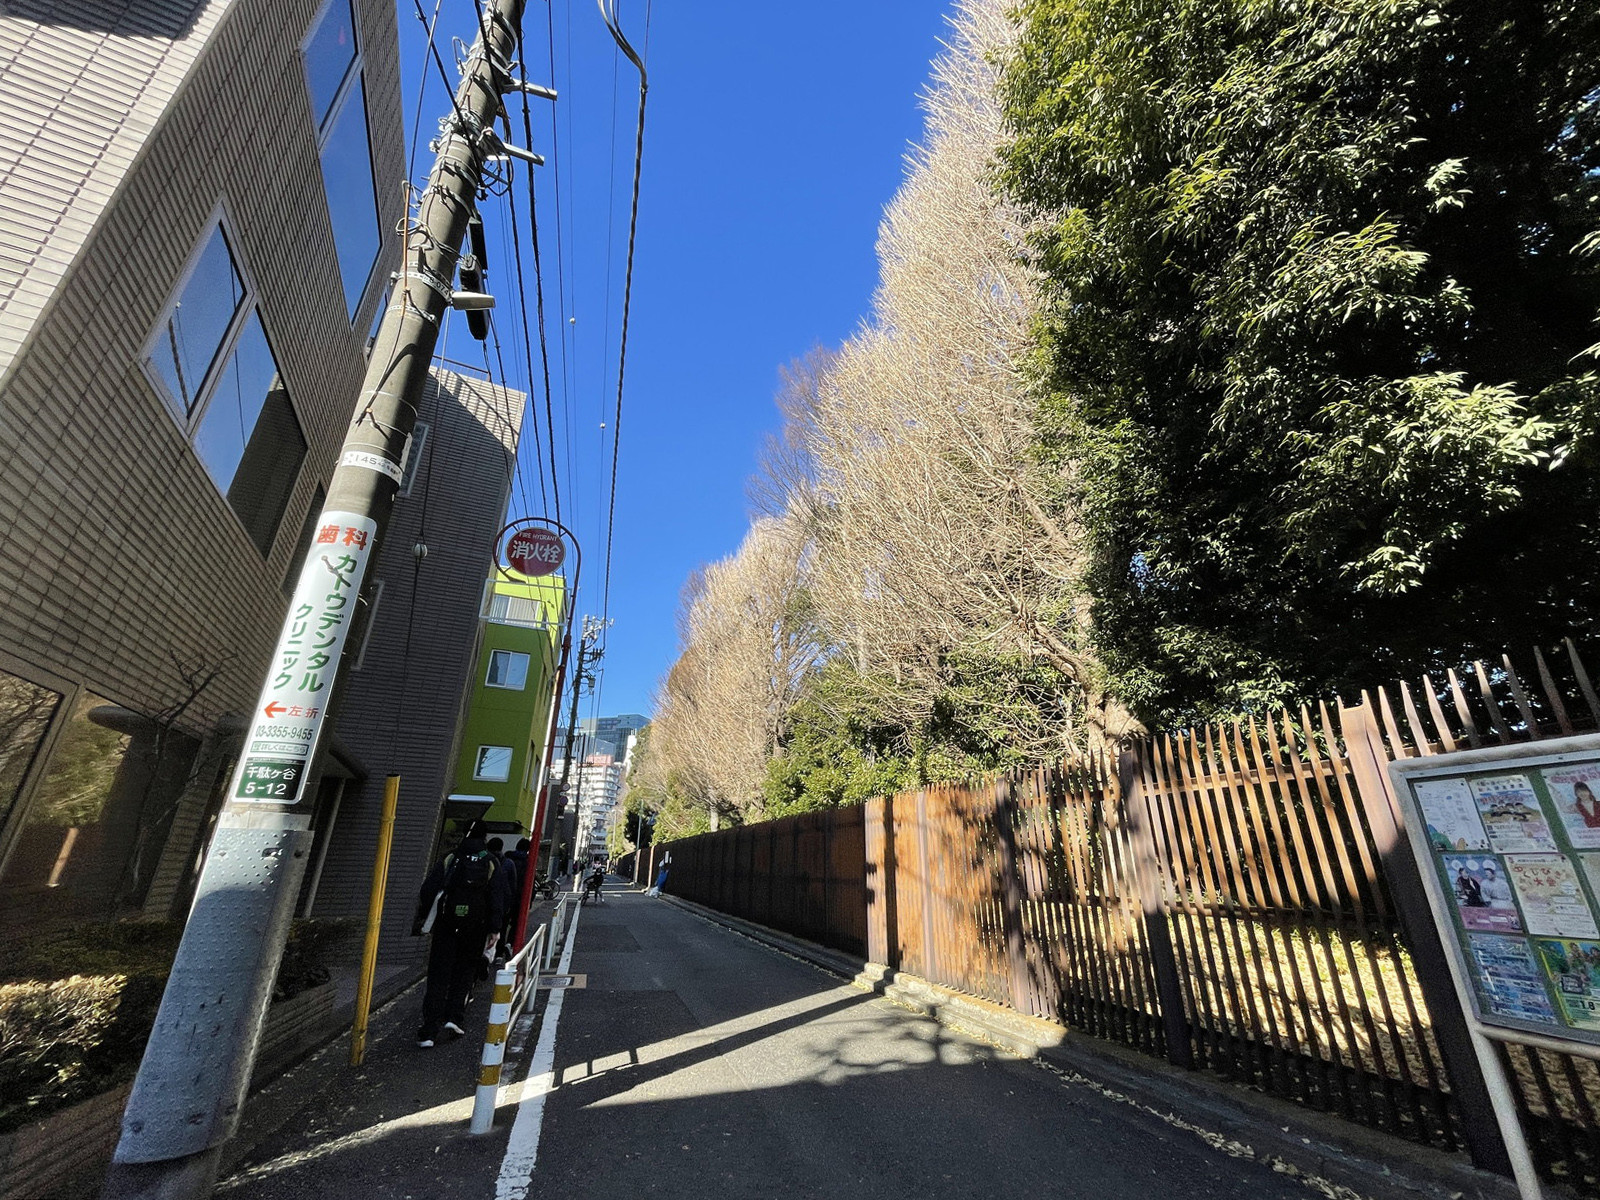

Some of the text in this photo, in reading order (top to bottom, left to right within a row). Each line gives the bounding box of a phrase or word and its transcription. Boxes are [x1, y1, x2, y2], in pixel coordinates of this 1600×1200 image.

[316, 524, 368, 551] 歯科
[518, 531, 558, 542] FIRE HYDRANT
[511, 540, 562, 564] 消火栓
[297, 553, 358, 693] カトウデンタル
[273, 603, 315, 690] クリニック
[288, 705, 319, 719] 左折
[255, 725, 314, 741] 03-3355-9455
[245, 782, 287, 795] 5-12
